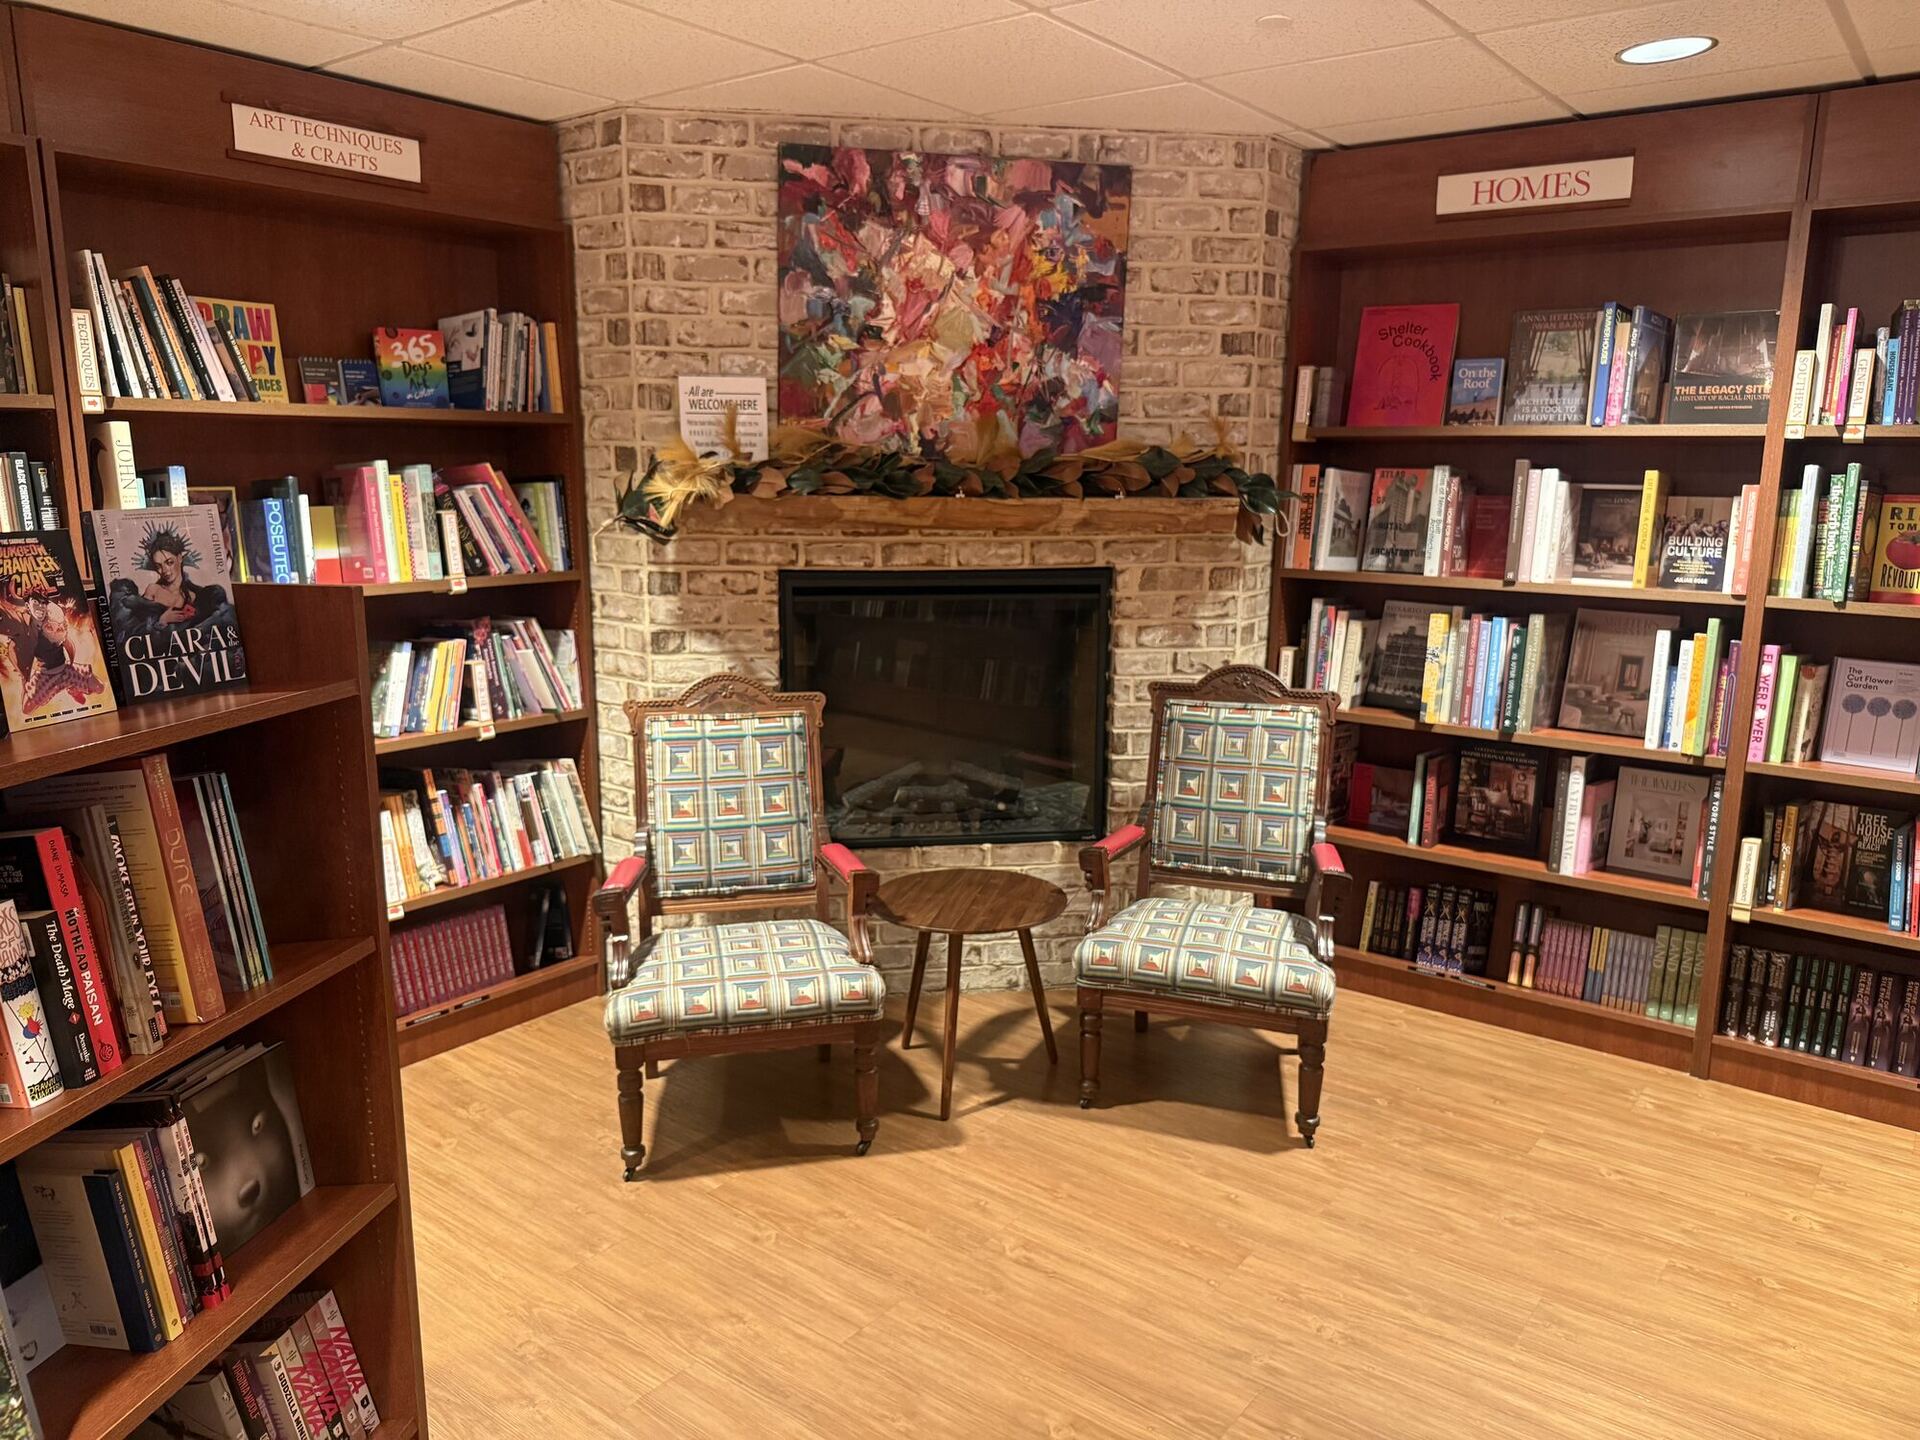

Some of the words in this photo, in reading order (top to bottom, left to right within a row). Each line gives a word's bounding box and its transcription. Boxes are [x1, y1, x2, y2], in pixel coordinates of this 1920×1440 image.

[250, 112, 286, 132] ART
[290, 119, 403, 155] TECHNIQUES
[292, 142, 305, 158] &
[311, 146, 378, 171] CRAFTS
[1472, 170, 1591, 206] HOMES
[1378, 321, 1428, 341] Shelter
[1520, 314, 1547, 323] ANNA
[76, 315, 95, 388] TECHNIQUES
[391, 333, 437, 368] 365
[1392, 335, 1442, 382] Cookbook
[401, 361, 432, 379] Days
[1458, 367, 1475, 379] On
[1478, 367, 1496, 379] the
[1463, 377, 1491, 389] Roof
[1851, 358, 1868, 409] GENERAL
[1886, 350, 1896, 391] HOUSEPLANT
[688, 386, 701, 397] All
[701, 388, 714, 397] are
[1674, 386, 1697, 395] THE
[1698, 385, 1743, 395] LEGACY
[1792, 356, 1808, 419] SOUTHERN
[688, 399, 733, 410] WELCOME
[736, 400, 758, 411] HERE
[1513, 414, 1556, 422] IMPROVE
[1558, 413, 1585, 422] LIVES
[1540, 406, 1563, 414] TOOL
[1565, 405, 1577, 413] TO
[13, 458, 26, 484] BLACK
[115, 438, 136, 490] JOHN
[17, 483, 35, 532] CHRONICLES
[206, 508, 216, 532] LITTLE
[1436, 496, 1444, 517] Never
[1889, 506, 1920, 521] RI
[1426, 518, 1435, 560] Architecture
[1434, 519, 1443, 535] Built
[1668, 536, 1723, 547] BUILDING
[0, 544, 48, 559] UNGEON
[103, 537, 119, 579] BLAKE
[210, 532, 226, 575] CHMURA
[1667, 546, 1722, 558] CULTURE
[1825, 530, 1838, 559] book
[9, 570, 58, 600] CARL
[95, 594, 112, 632] CLARA
[124, 625, 227, 662] CLARA
[227, 626, 238, 639] &
[228, 638, 239, 647] the
[129, 650, 246, 697] DEVIL
[1846, 680, 1878, 690] Garden
[1847, 674, 1863, 682] Cut
[1865, 675, 1893, 685] Flower
[1849, 666, 1863, 675] The
[1712, 780, 1721, 798] NEW
[1709, 800, 1719, 823] YORK
[1860, 812, 1888, 826] TREE
[1705, 824, 1716, 851] STYLE
[1856, 823, 1895, 840] HOUSE
[1858, 841, 1880, 851] REACH
[1863, 835, 1888, 846] WITHIN
[1896, 835, 1904, 848] SAFE
[48, 839, 59, 864] DIANE
[165, 827, 193, 897] DUNE
[1895, 849, 1903, 860] AND
[1894, 861, 1903, 881] SOUND
[45, 920, 63, 942] The
[127, 911, 138, 924] IN
[133, 925, 151, 966] YOUR
[51, 943, 71, 977] Death
[1651, 933, 1667, 968] LAND
[1665, 936, 1681, 972] LAND
[1680, 939, 1694, 974] LAND
[64, 908, 89, 972] HOTHEAD
[80, 970, 103, 1026] PAISAN
[60, 977, 76, 1010] Mage
[1854, 971, 1868, 1003] SILENCE
[1875, 975, 1889, 1008] SILENCE
[1902, 980, 1915, 1012] SILENCE
[78, 1032, 92, 1063] Densuke
[315, 1334, 355, 1408] NANA
[328, 1322, 368, 1395] NANA
[231, 1359, 252, 1396] VIRGINIA
[242, 1393, 260, 1420] WOOLF
[277, 1371, 300, 1416] GODZILLA
[280, 1361, 334, 1438] NANA
[296, 1350, 343, 1423] NANA
